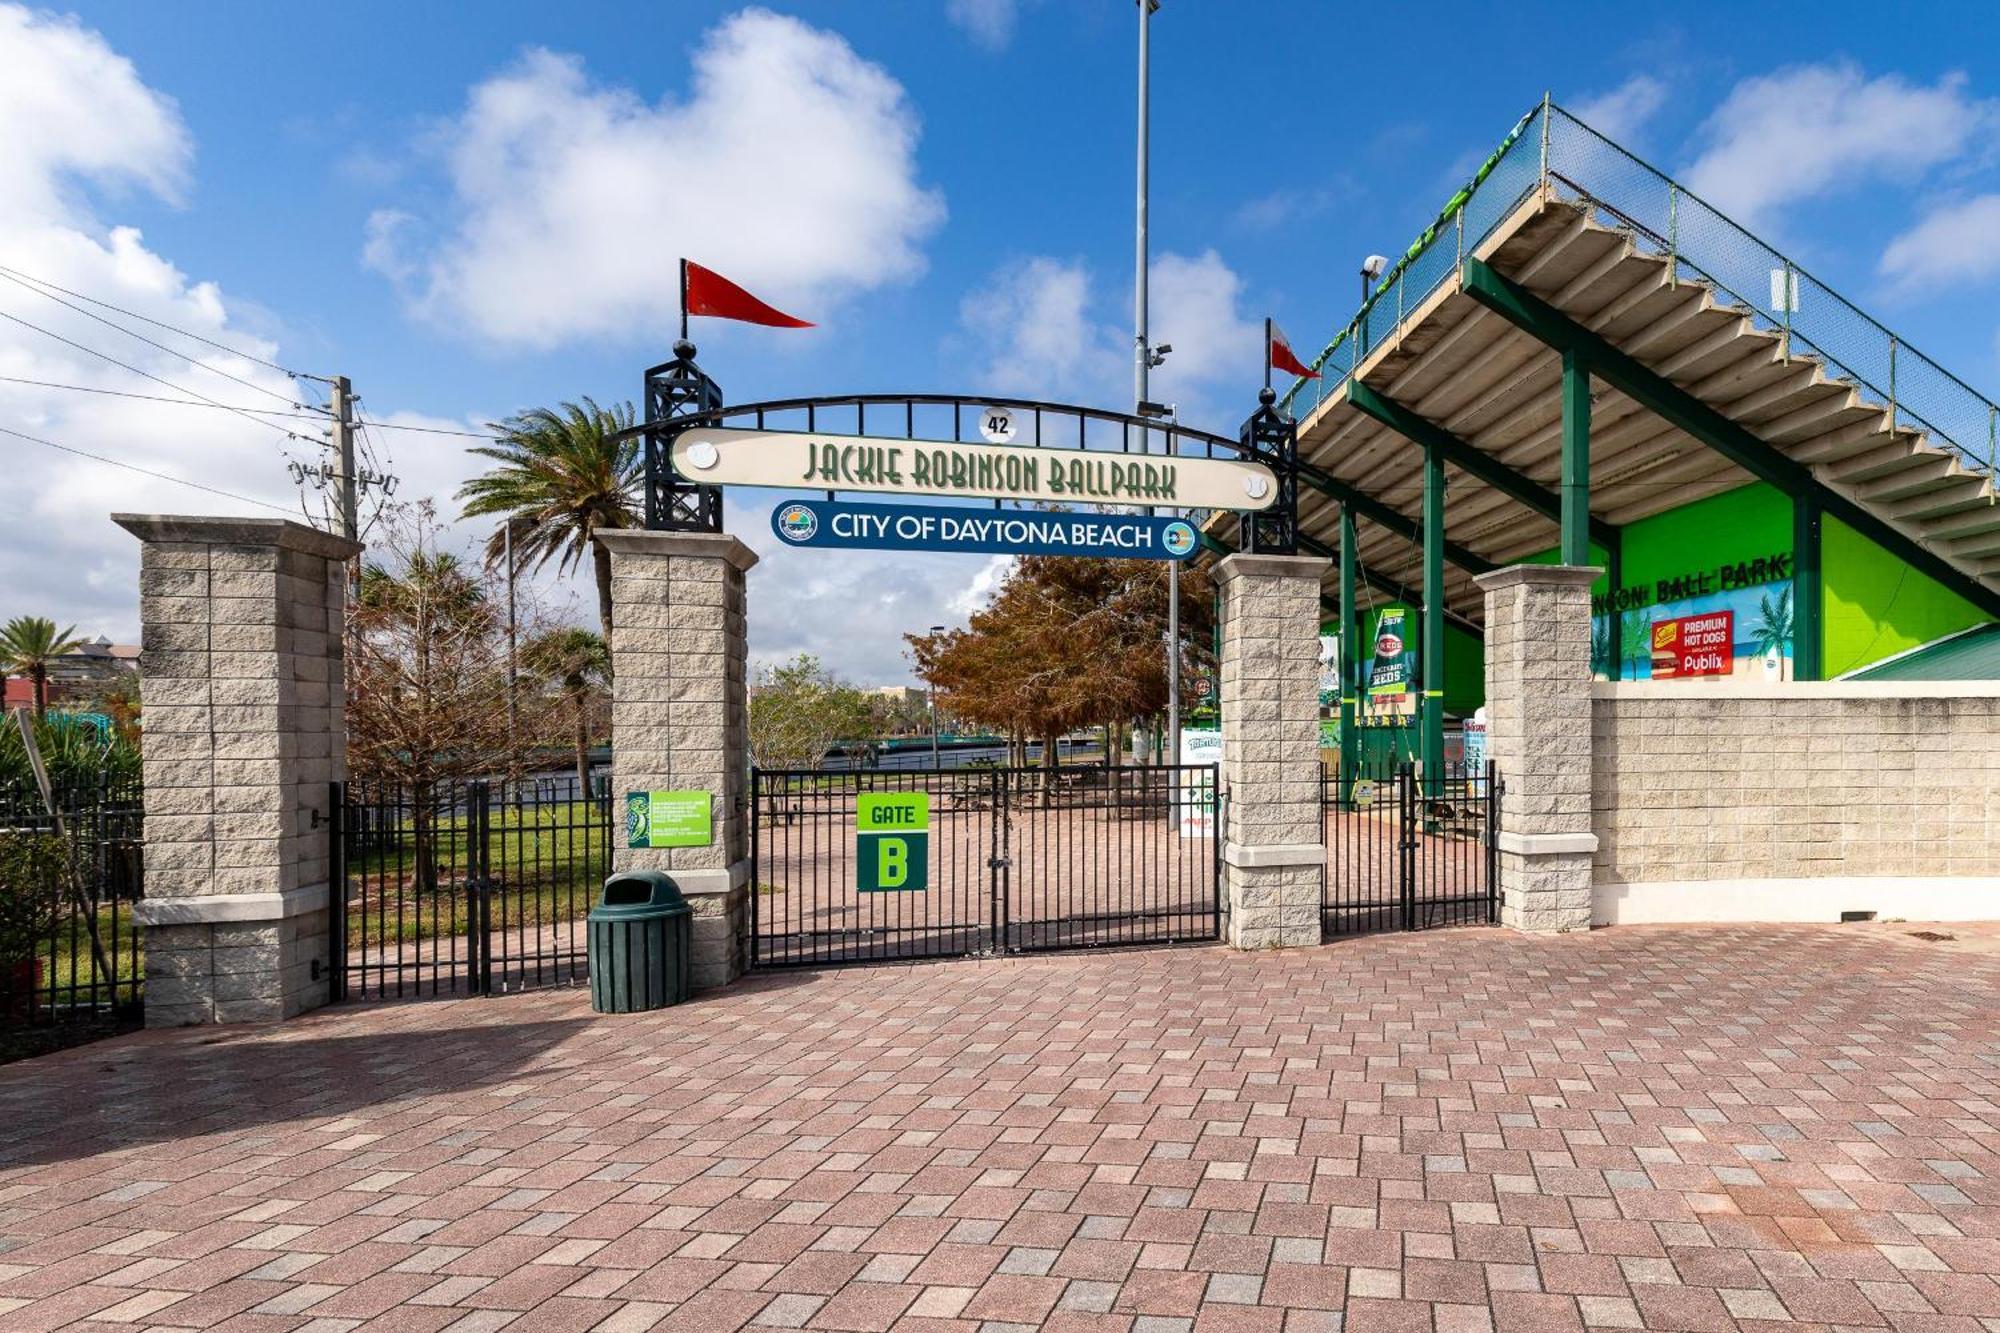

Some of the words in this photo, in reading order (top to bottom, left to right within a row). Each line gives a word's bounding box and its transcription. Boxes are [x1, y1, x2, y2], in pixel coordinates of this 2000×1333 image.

[988, 416, 1008, 433] 42
[803, 443, 904, 484] JACKIE
[910, 448, 1038, 492] ROBINSON
[1047, 456, 1177, 499] BALLPARK
[831, 513, 891, 538] CITY
[896, 515, 935, 539] OF
[941, 518, 1068, 544] DAYTONA
[1072, 523, 1152, 547] BEACH
[1656, 571, 1709, 603] BALL
[1721, 553, 1787, 590] PARK
[1684, 616, 1727, 634] PREMIUM
[1684, 634, 1701, 646] HOT
[1703, 631, 1726, 645] DOGS
[872, 806, 915, 824] GATE
[878, 837, 908, 887] B
